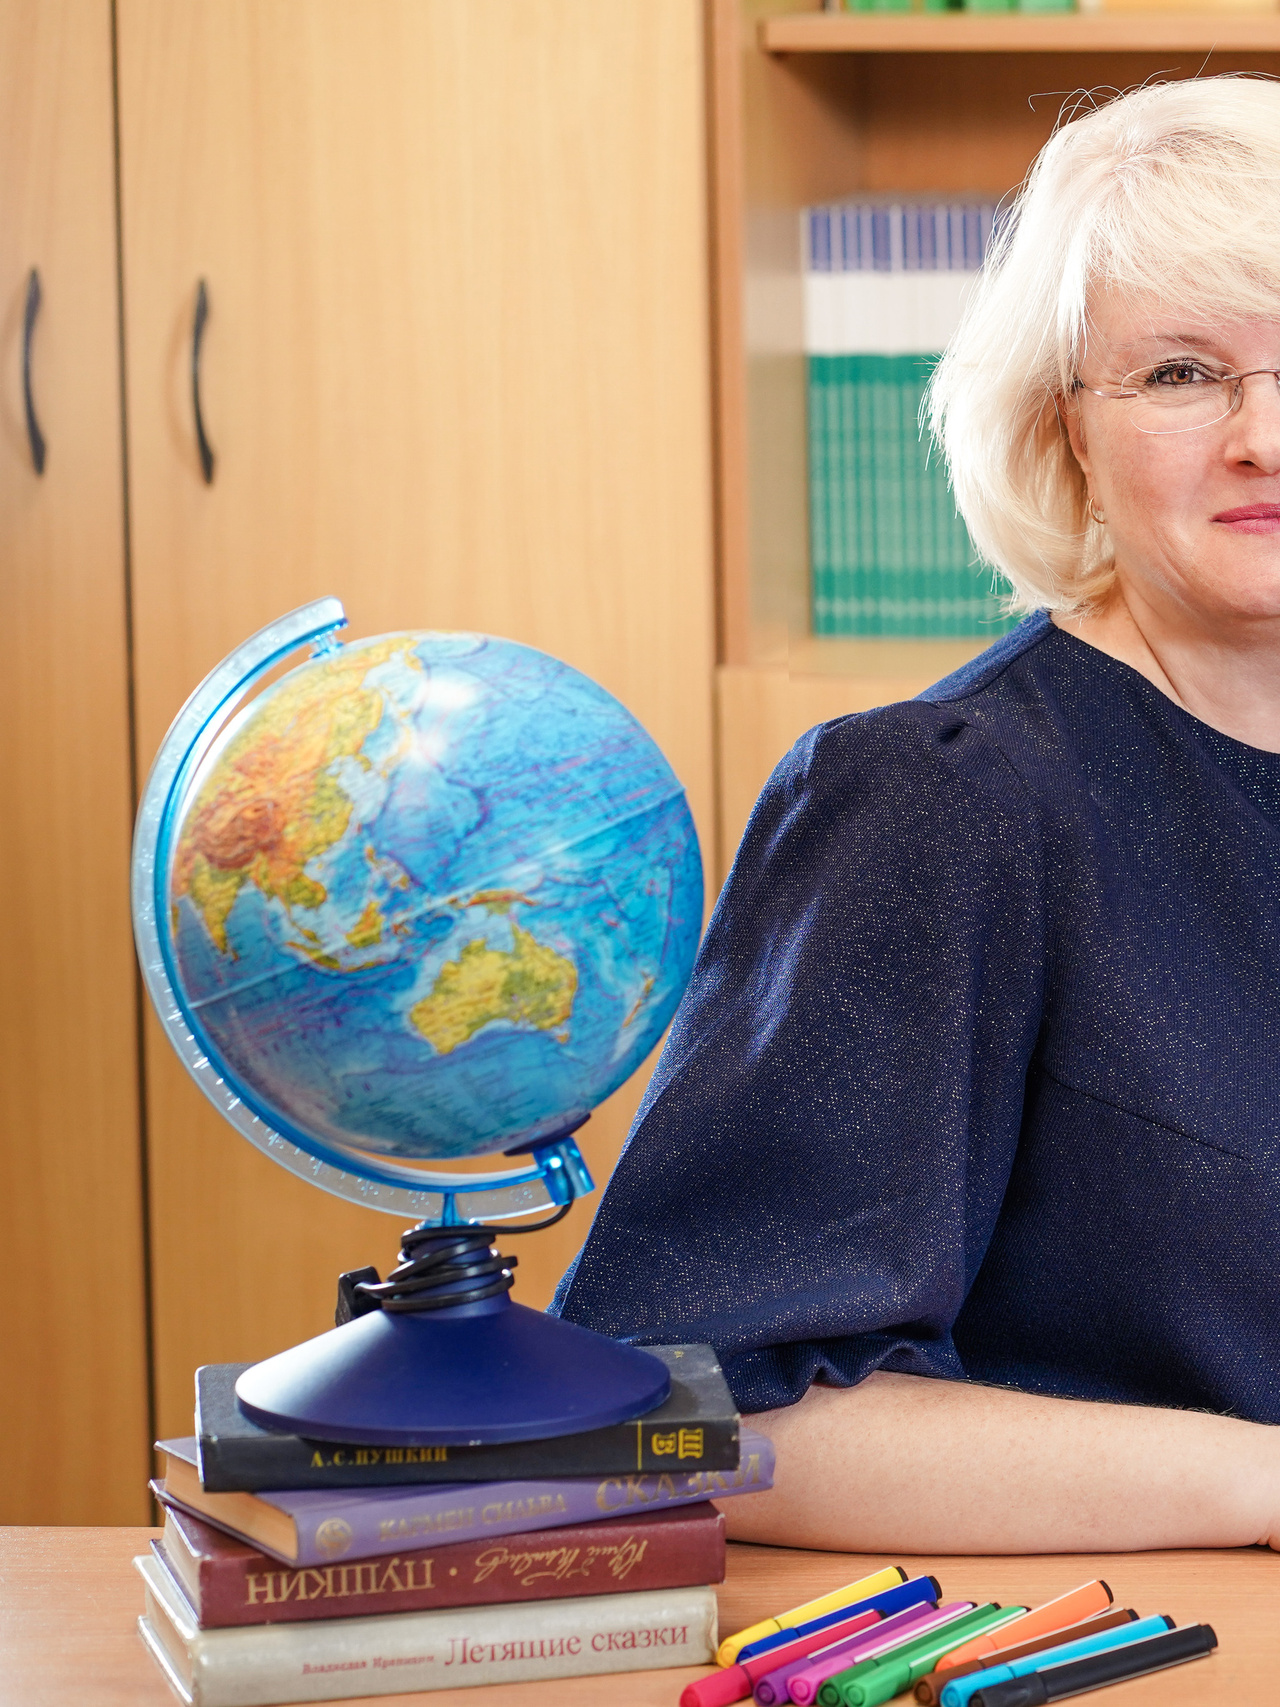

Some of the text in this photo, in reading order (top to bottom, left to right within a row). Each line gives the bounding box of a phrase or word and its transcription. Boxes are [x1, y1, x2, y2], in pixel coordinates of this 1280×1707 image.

[596, 1453, 760, 1511] СКАЗКИ
[245, 1557, 436, 1605] ПУШКИН
[444, 1635, 582, 1666] Летящие
[591, 1625, 690, 1652] сказки
